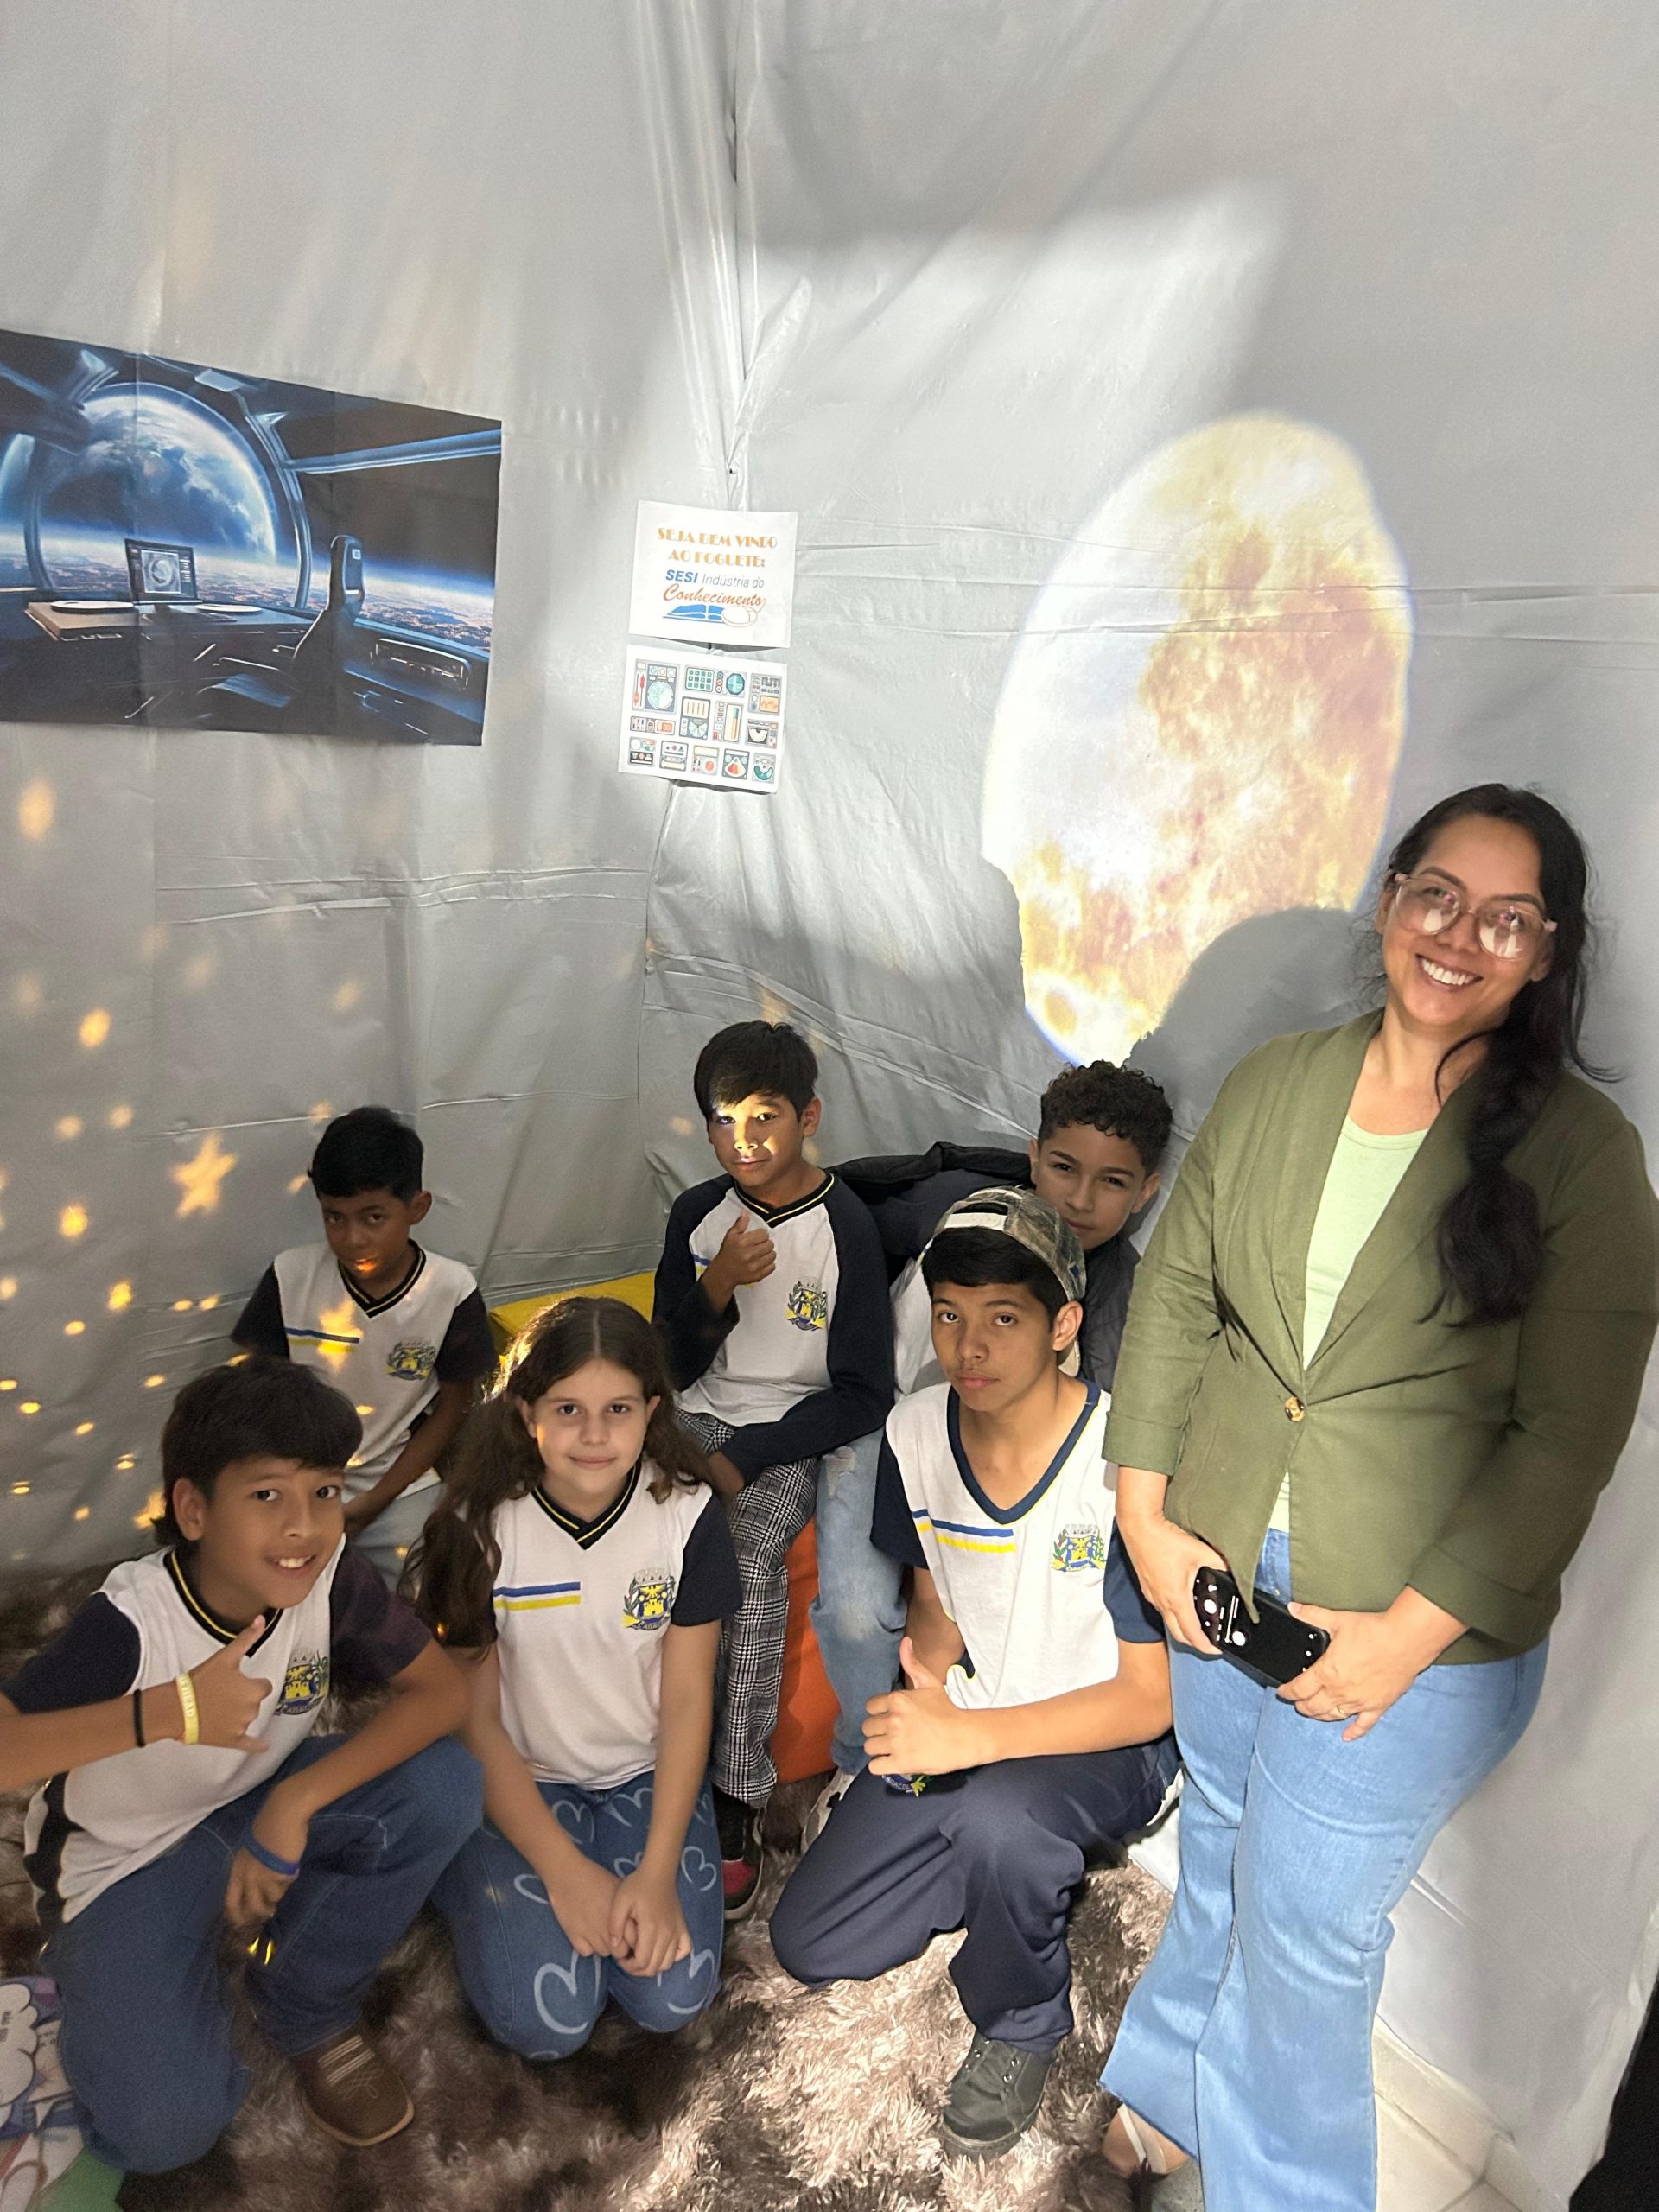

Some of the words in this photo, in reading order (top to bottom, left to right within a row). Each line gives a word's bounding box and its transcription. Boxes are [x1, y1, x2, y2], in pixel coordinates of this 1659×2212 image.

[658, 527, 695, 543] SEJA
[698, 533, 731, 546] BEM
[734, 535, 778, 549] VINDO
[668, 550, 690, 562] AO
[694, 551, 766, 568] FOGUETE:
[665, 569, 698, 583] SESI
[702, 573, 749, 588] Indústria
[752, 576, 765, 588] do
[663, 583, 763, 606] Conhecimento
